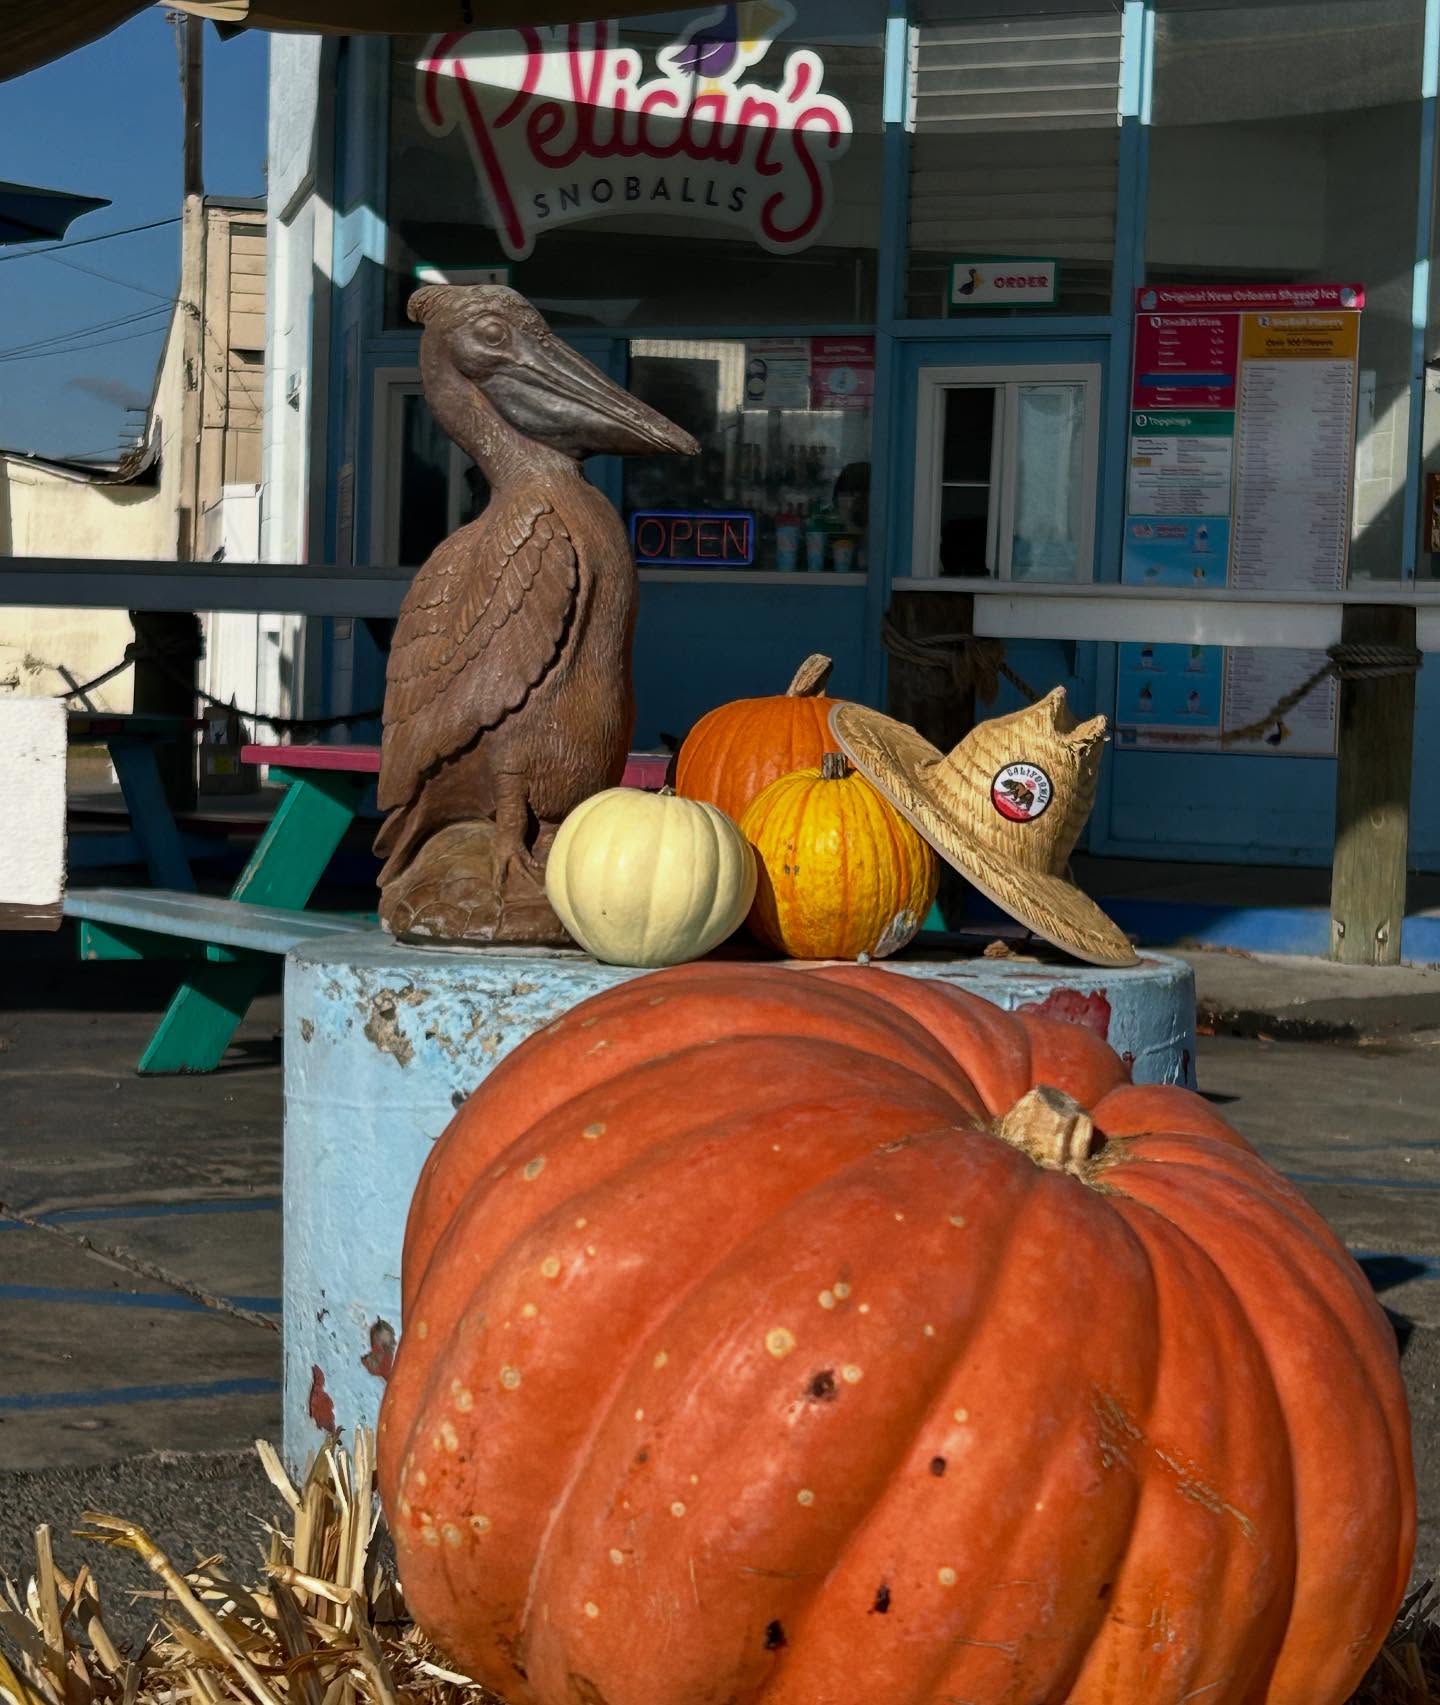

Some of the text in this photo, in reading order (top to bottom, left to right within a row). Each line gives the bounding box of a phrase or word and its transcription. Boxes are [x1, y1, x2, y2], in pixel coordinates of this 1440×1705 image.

[425, 20, 840, 250] Pelican's
[533, 176, 750, 218] SNOBALLS
[993, 276, 1049, 289] ORDER
[1160, 291, 1205, 303] Original
[1207, 291, 1231, 301] New
[1232, 290, 1277, 301] Orleans
[637, 519, 749, 559] OPEN
[1006, 766, 1048, 803] CALIFORNIA
